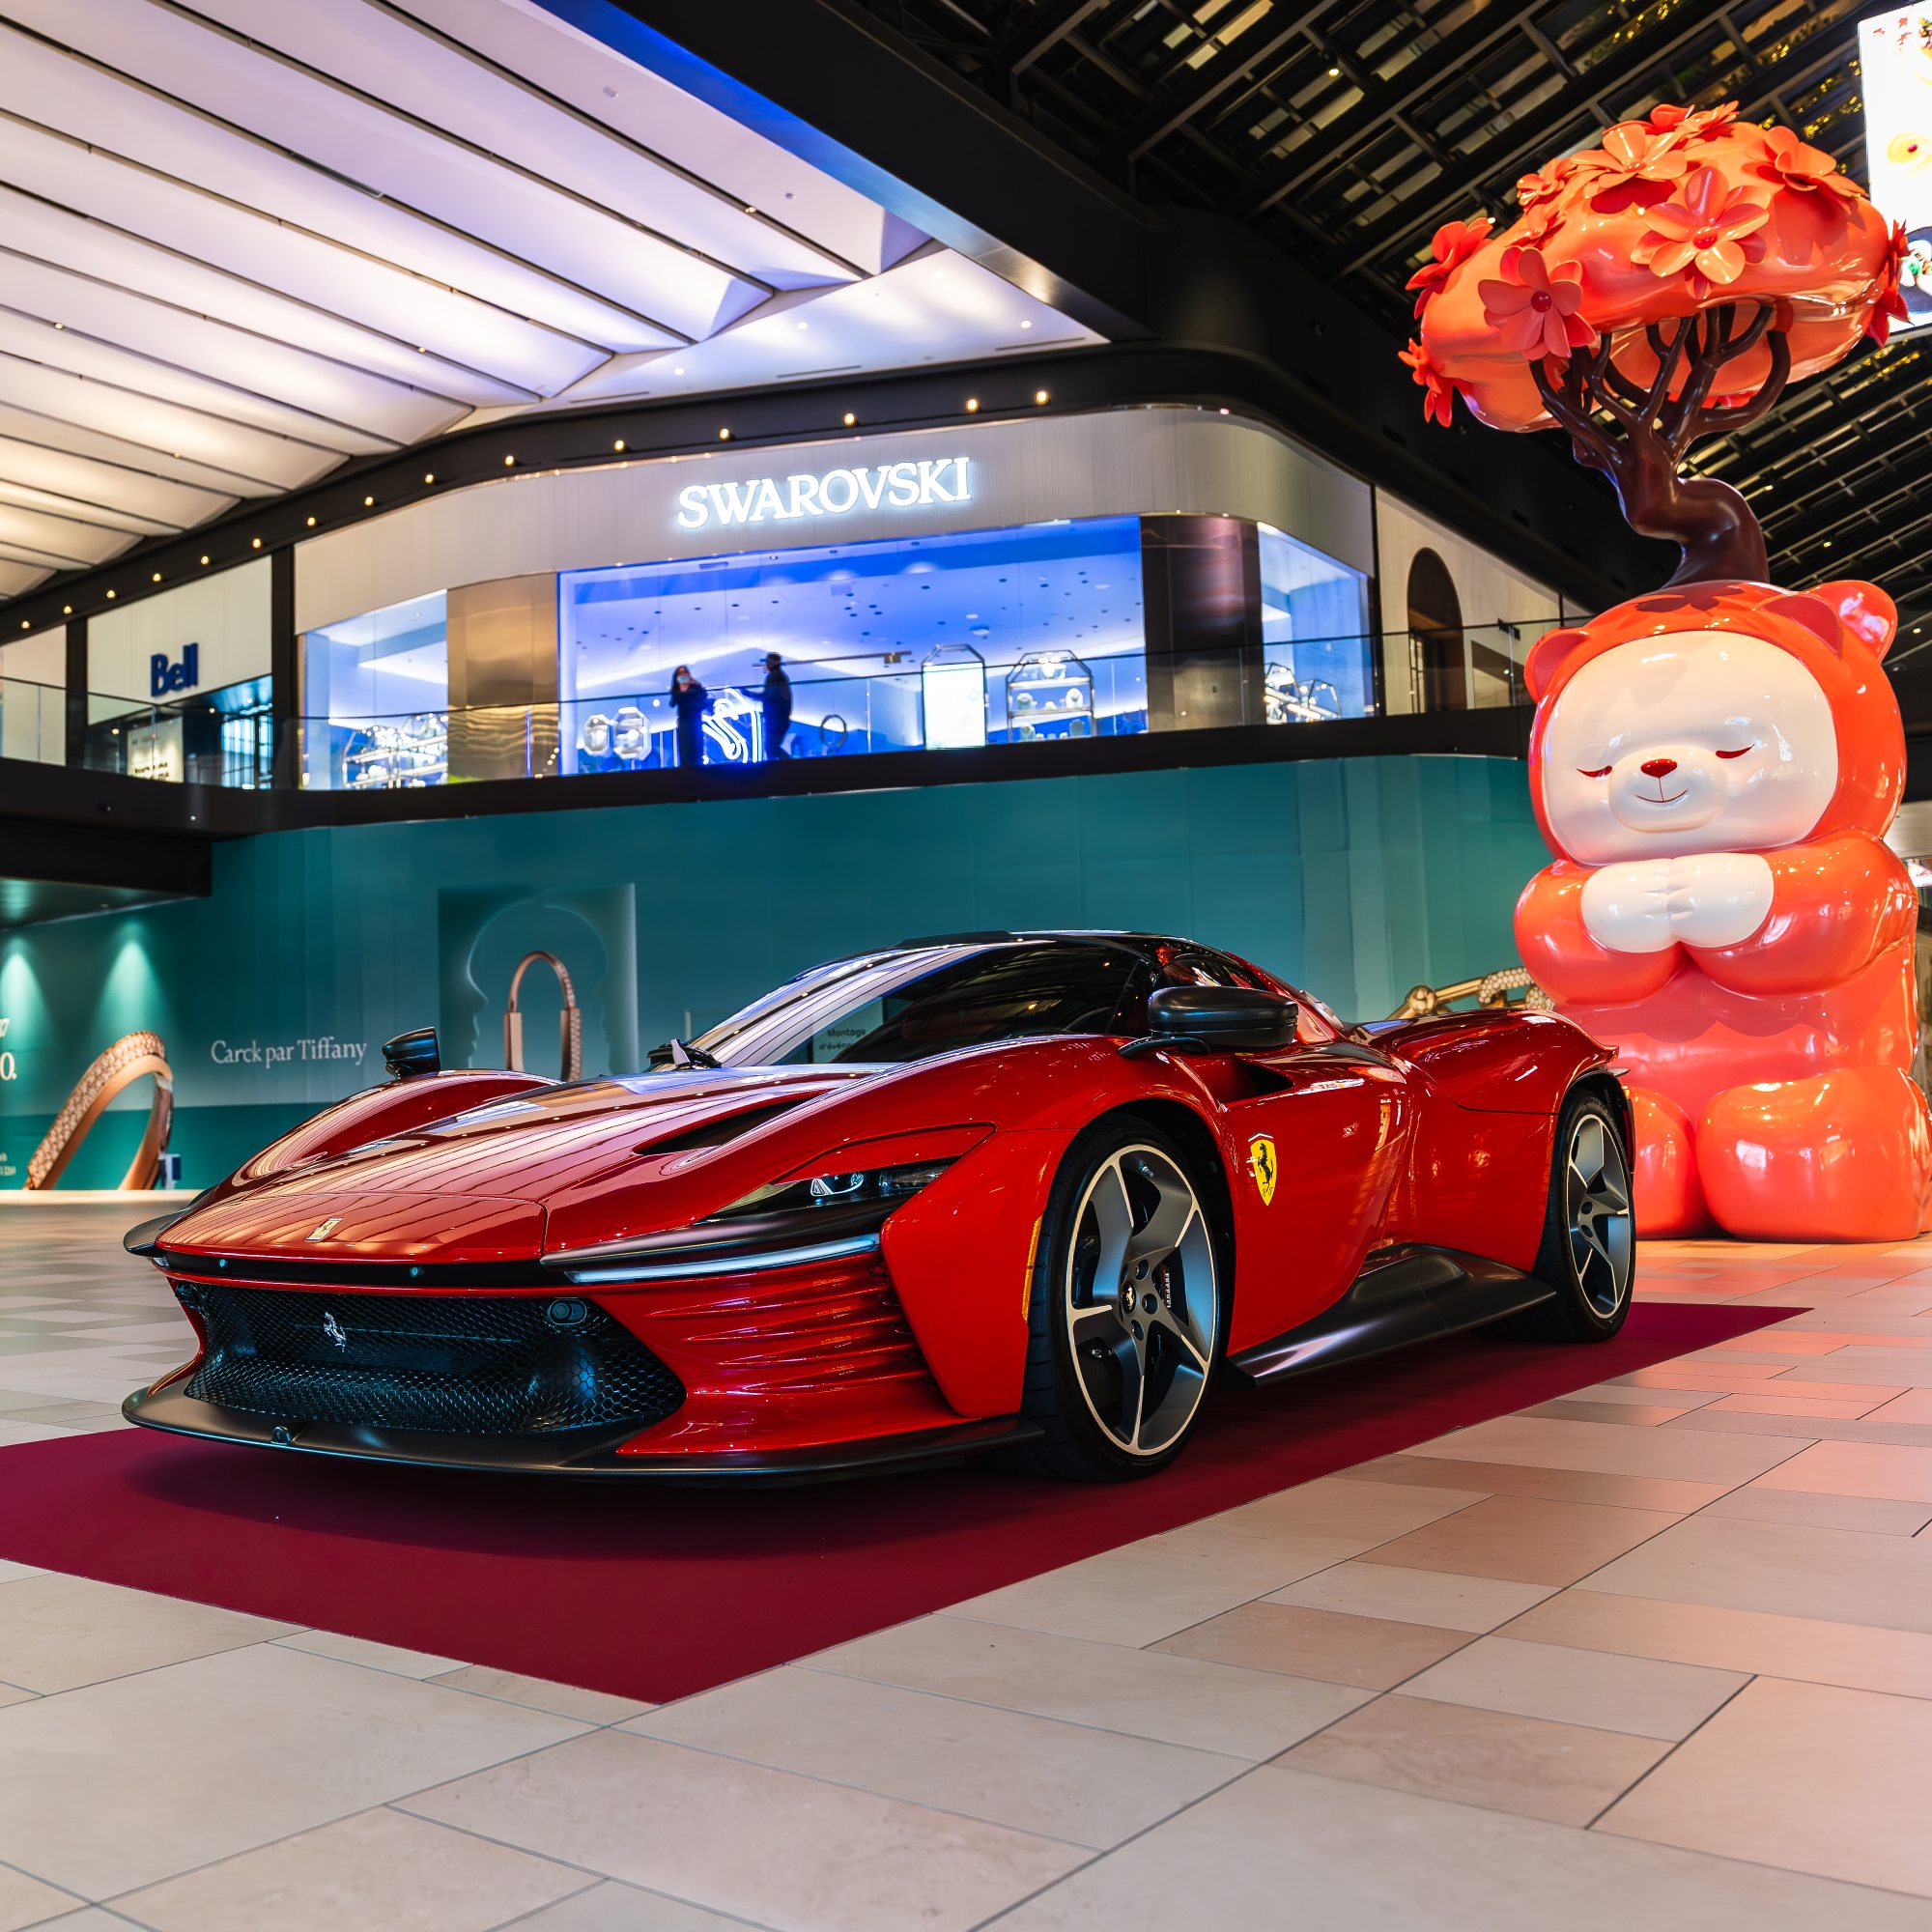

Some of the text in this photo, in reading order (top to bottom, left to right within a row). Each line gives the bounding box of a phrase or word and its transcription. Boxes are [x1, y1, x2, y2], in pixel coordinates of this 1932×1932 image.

[678, 457, 971, 528] SWAROVSKI
[151, 642, 198, 696] Bell
[265, 1045, 295, 1069] par
[297, 1036, 367, 1066] Tiffany
[827, 1028, 867, 1037] Montage
